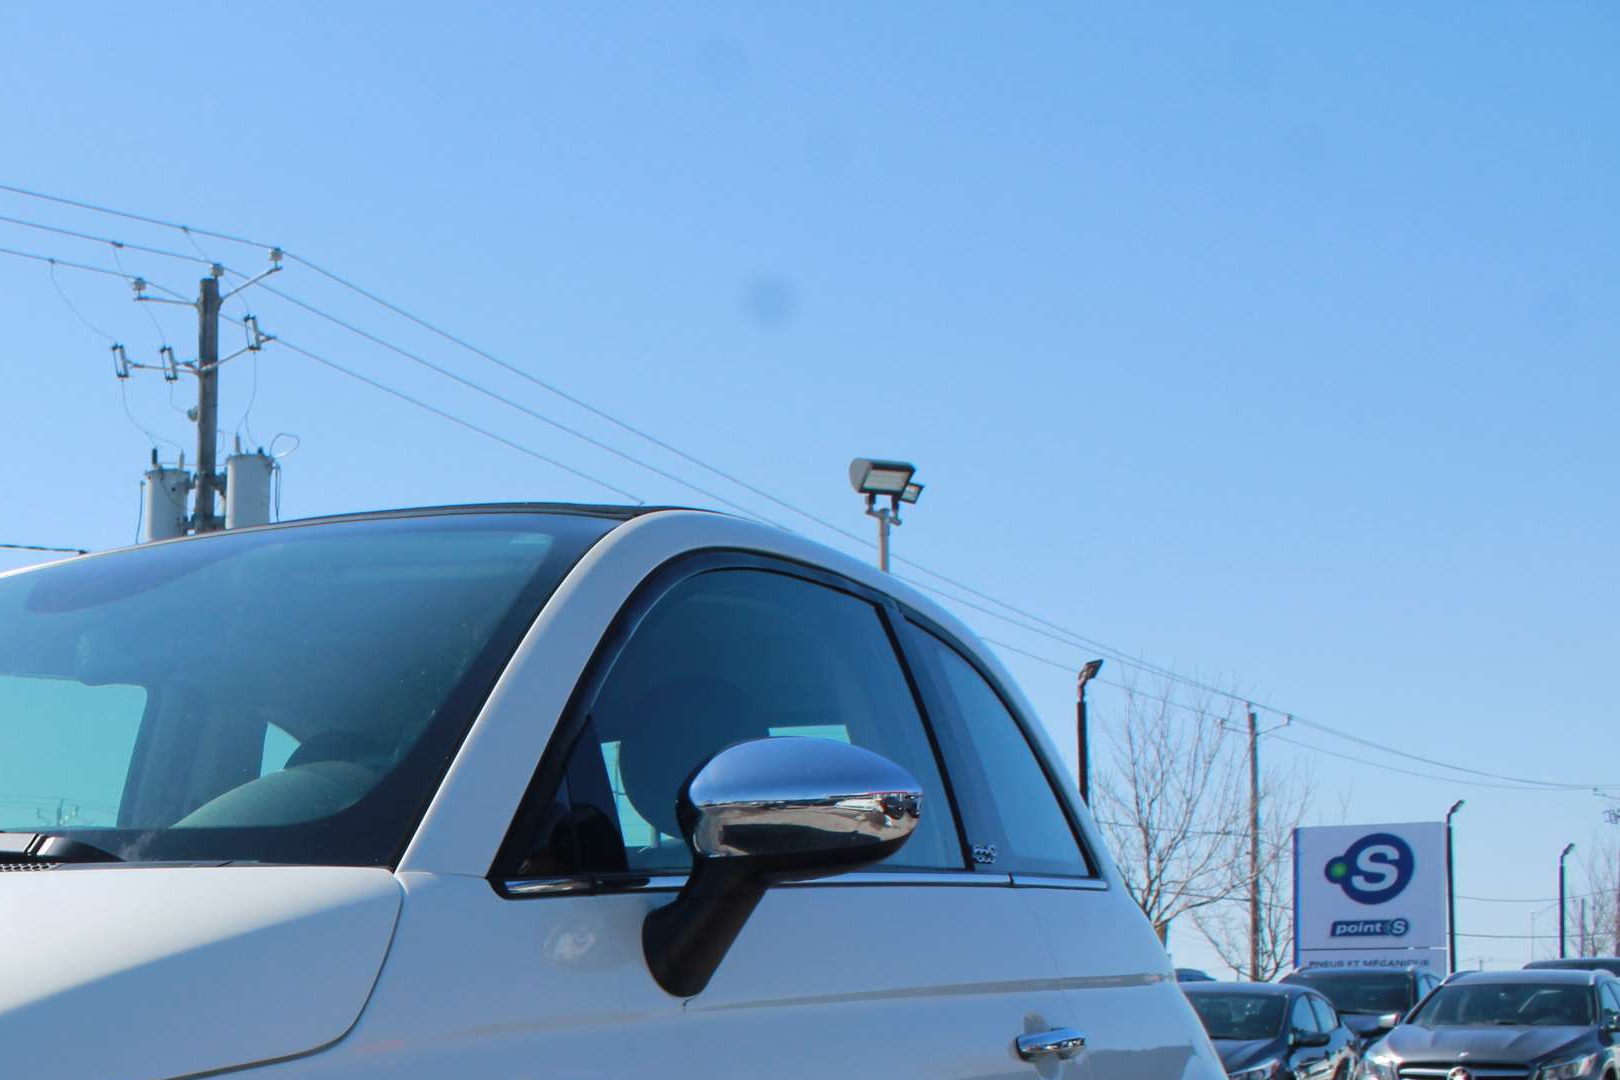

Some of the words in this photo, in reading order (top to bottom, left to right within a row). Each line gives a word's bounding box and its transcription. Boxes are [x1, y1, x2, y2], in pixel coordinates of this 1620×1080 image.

[1351, 844, 1400, 892] S
[1336, 922, 1383, 935] point
[1391, 920, 1406, 934] S
[1309, 960, 1345, 969] PNEUS
[1348, 959, 1360, 969] ET
